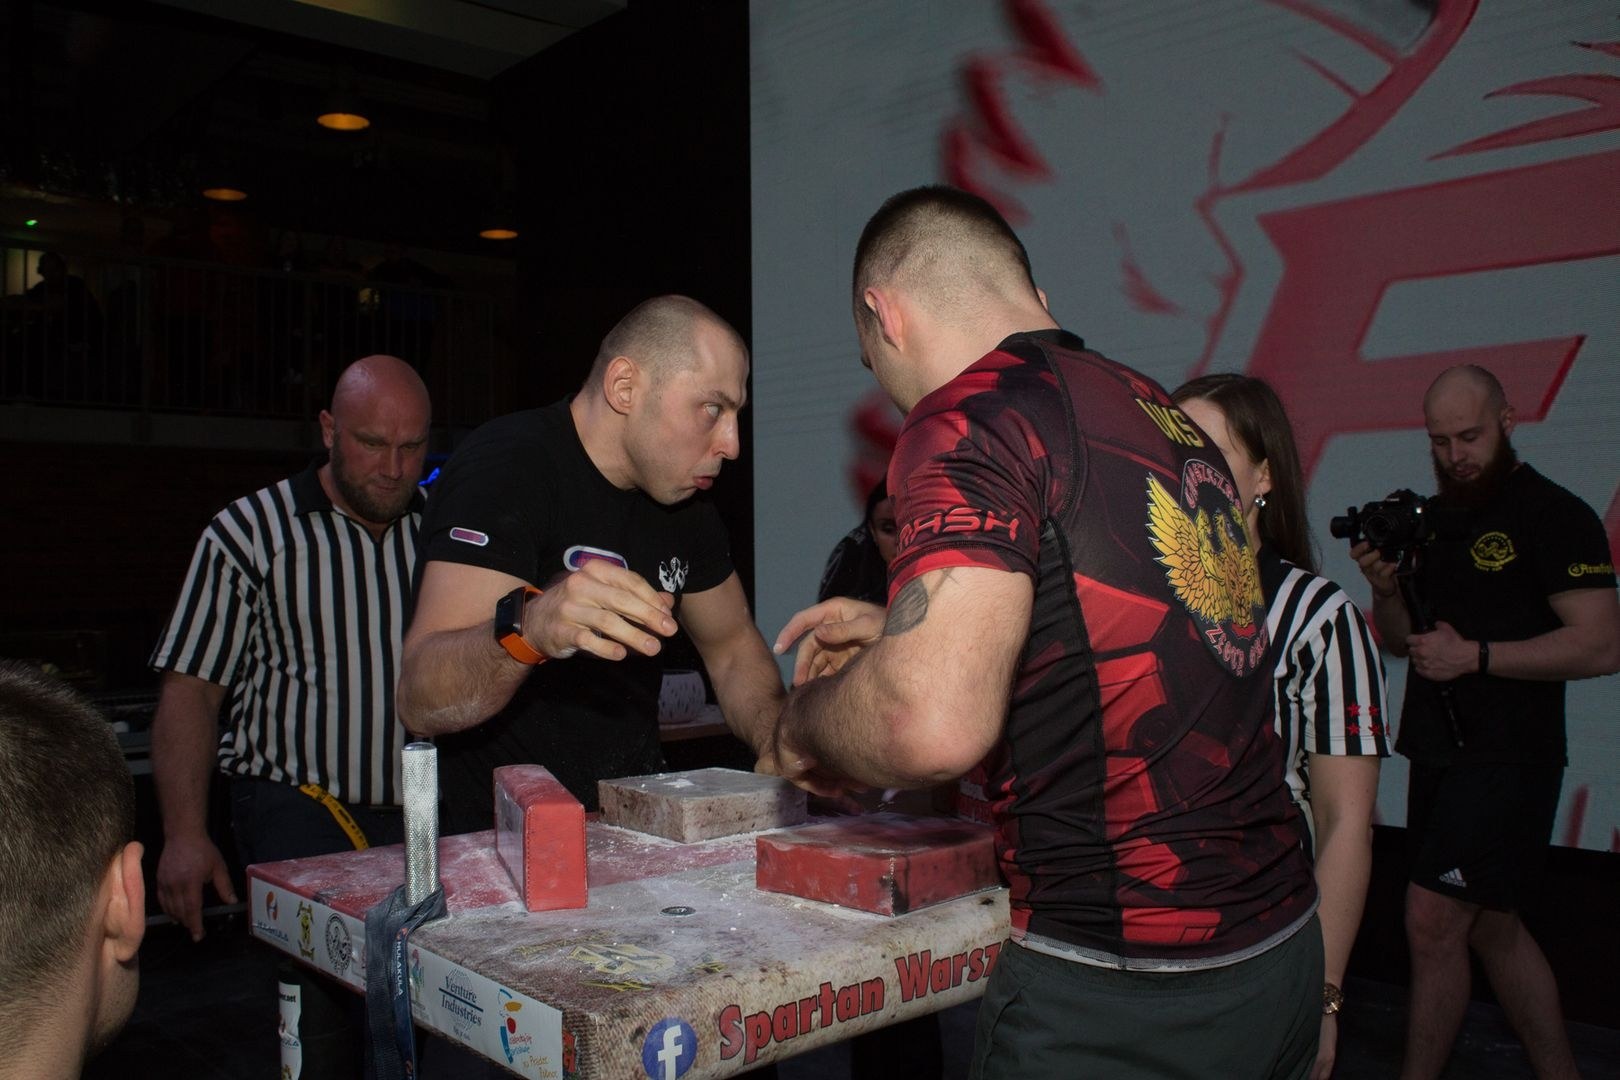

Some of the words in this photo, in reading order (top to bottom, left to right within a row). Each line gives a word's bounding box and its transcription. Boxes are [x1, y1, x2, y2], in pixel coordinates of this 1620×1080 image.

[395, 941, 405, 996] HULAKULA
[445, 975, 478, 1004] Venture
[441, 994, 482, 1027] Industries
[718, 976, 885, 1065] Spartan
